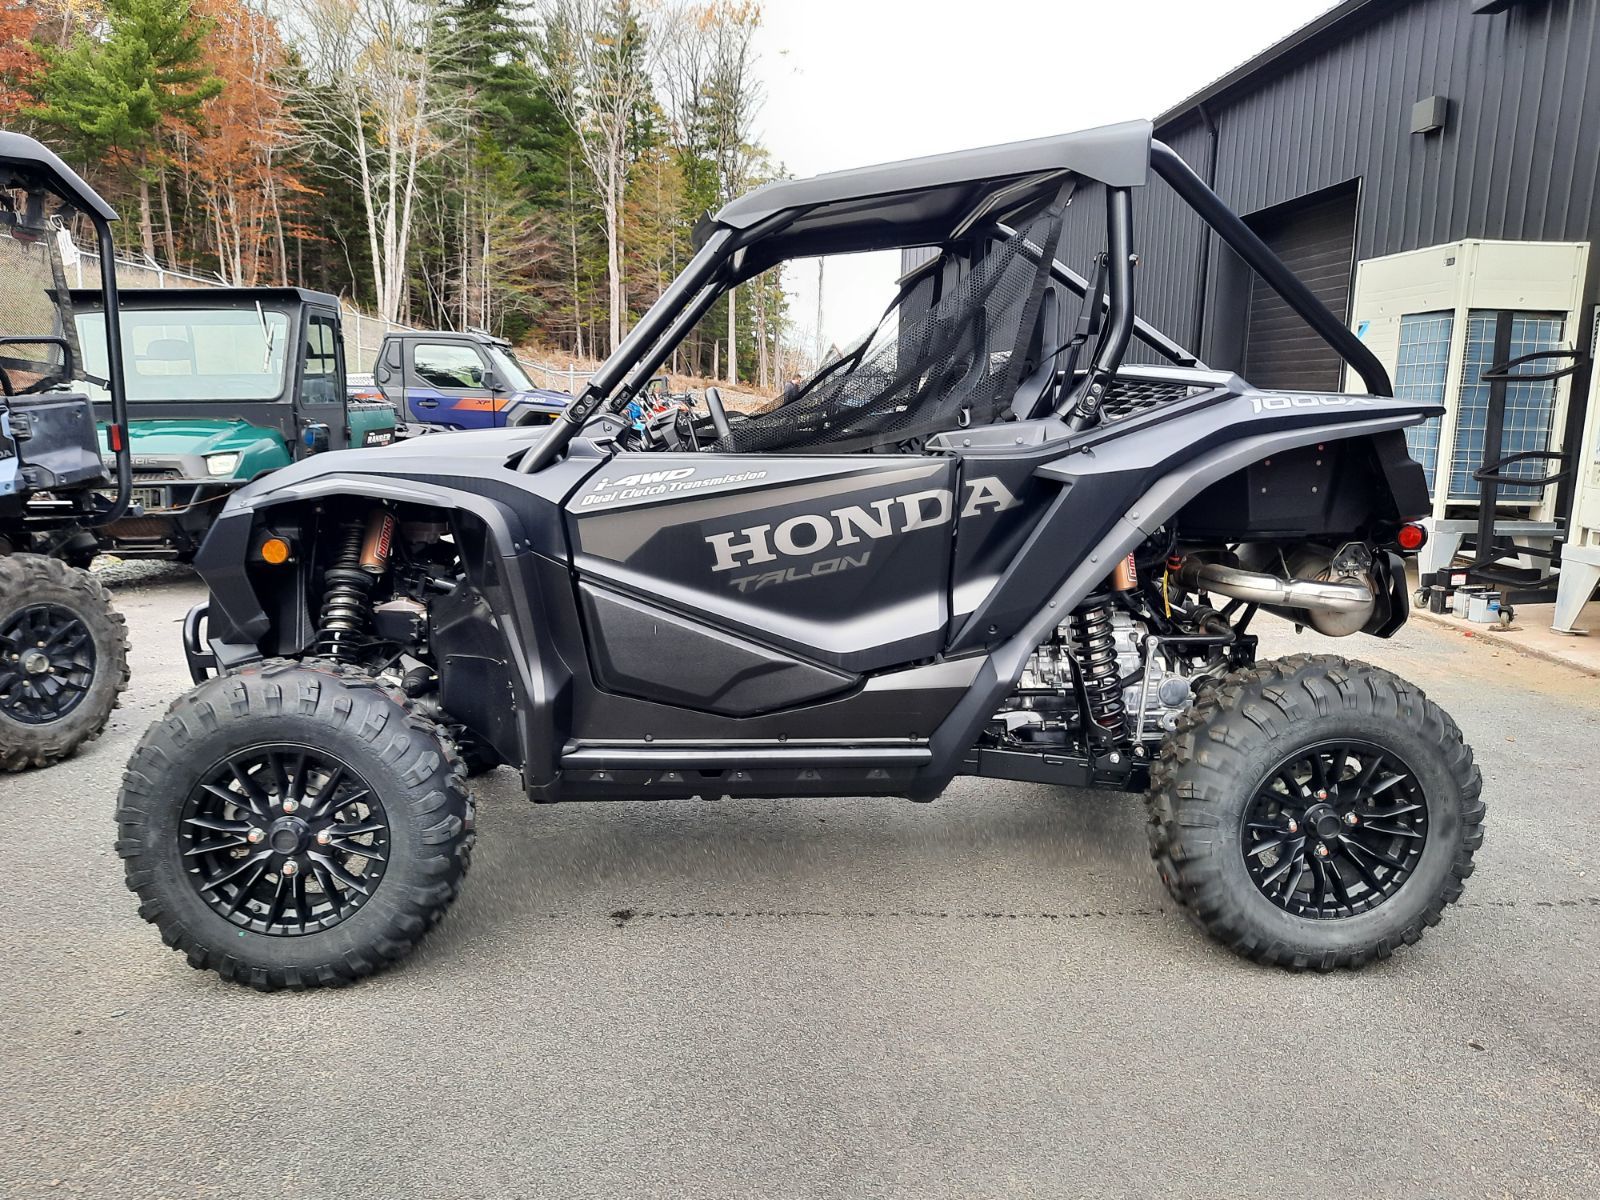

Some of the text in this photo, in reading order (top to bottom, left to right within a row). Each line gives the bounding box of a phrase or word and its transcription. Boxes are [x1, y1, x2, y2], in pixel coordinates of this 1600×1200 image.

[524, 396, 546, 404] 1000
[1249, 396, 1376, 415] 1000X
[580, 471, 768, 506] Dual Clutch Transmission
[593, 467, 696, 492] i-4WD
[705, 477, 1016, 572] HONDA
[729, 551, 871, 593] TALON
